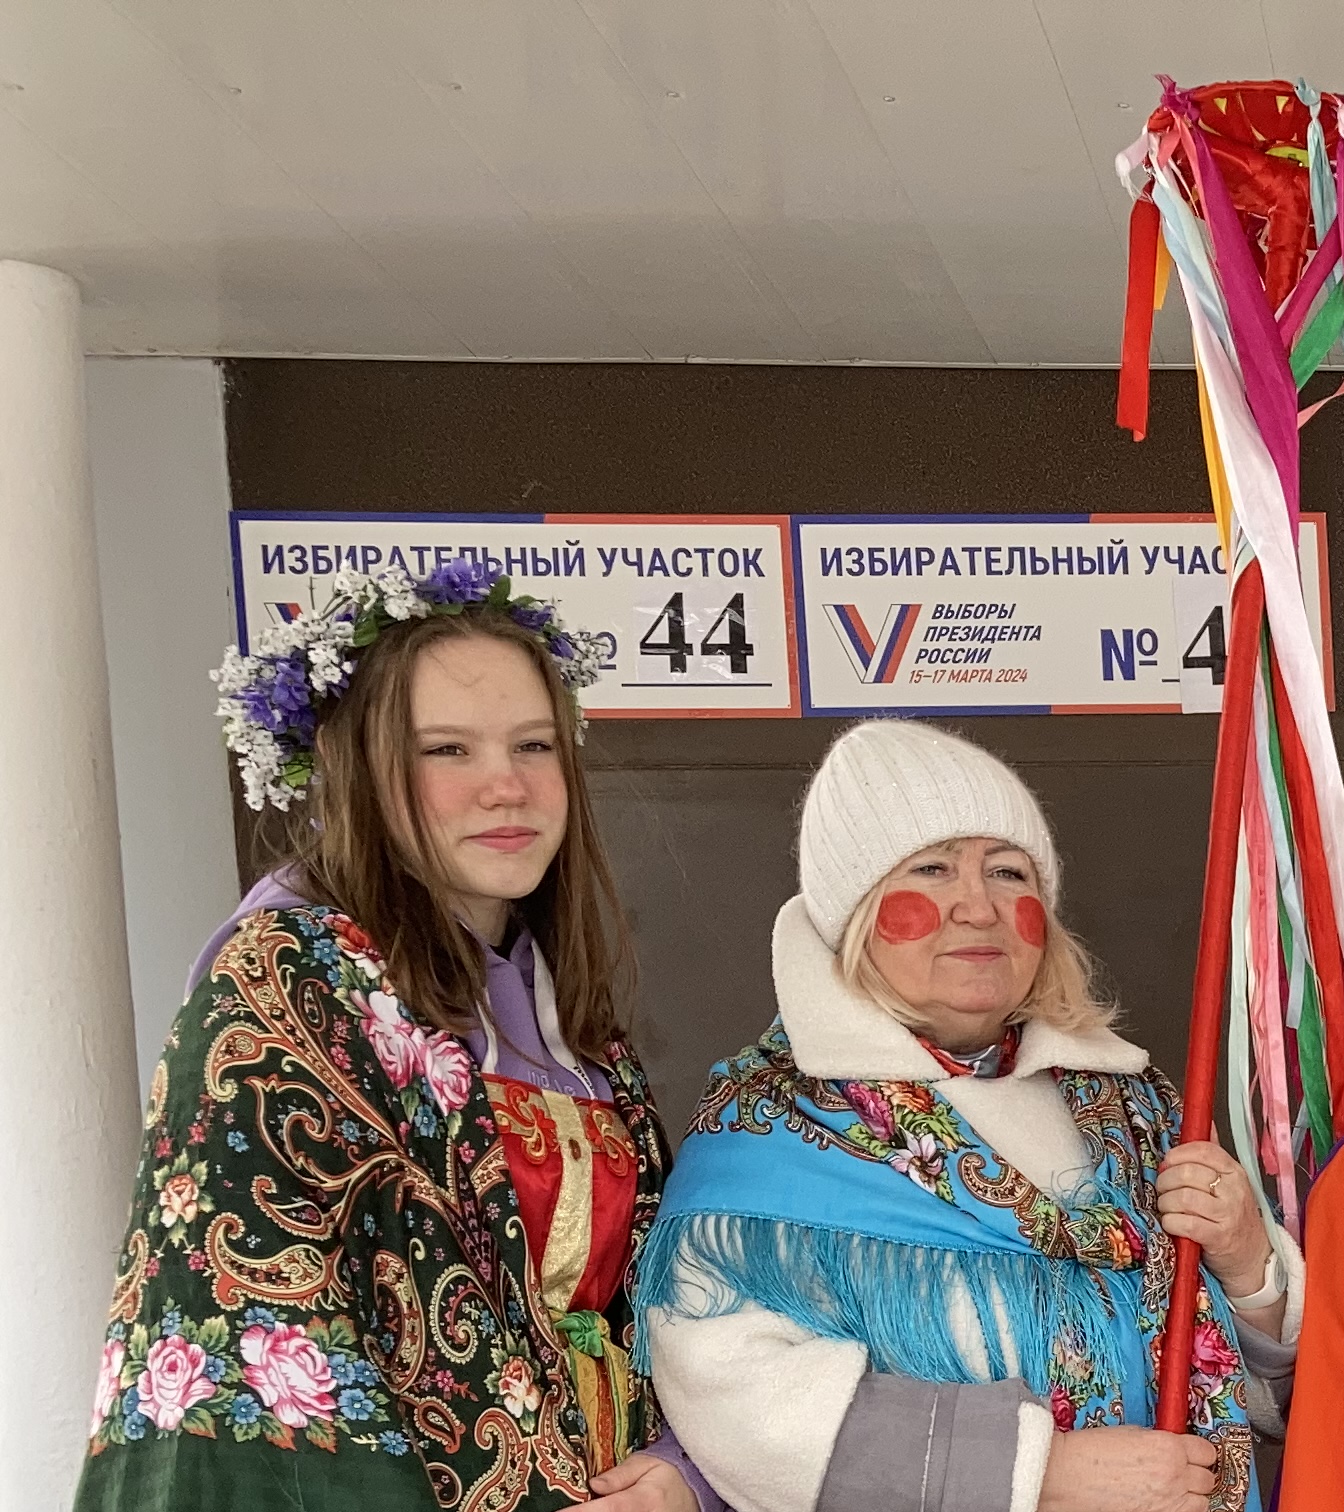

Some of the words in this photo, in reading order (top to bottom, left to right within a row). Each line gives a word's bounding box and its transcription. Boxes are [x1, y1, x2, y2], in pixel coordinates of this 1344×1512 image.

[597, 547, 766, 578] УЧАСТОК
[820, 538, 1129, 577] ИЗБИРАТЕЛЬНЫЙ
[1140, 546, 1227, 575] УЧАС
[931, 603, 1016, 619] ВЫБОРЫ
[639, 592, 754, 674] 44
[923, 625, 1042, 644] ПРЕЗИДЕНТА
[1182, 605, 1229, 686] 4
[914, 648, 992, 664] РОССИИ
[947, 669, 993, 683] МАРТА
[995, 668, 1028, 683] 2024
